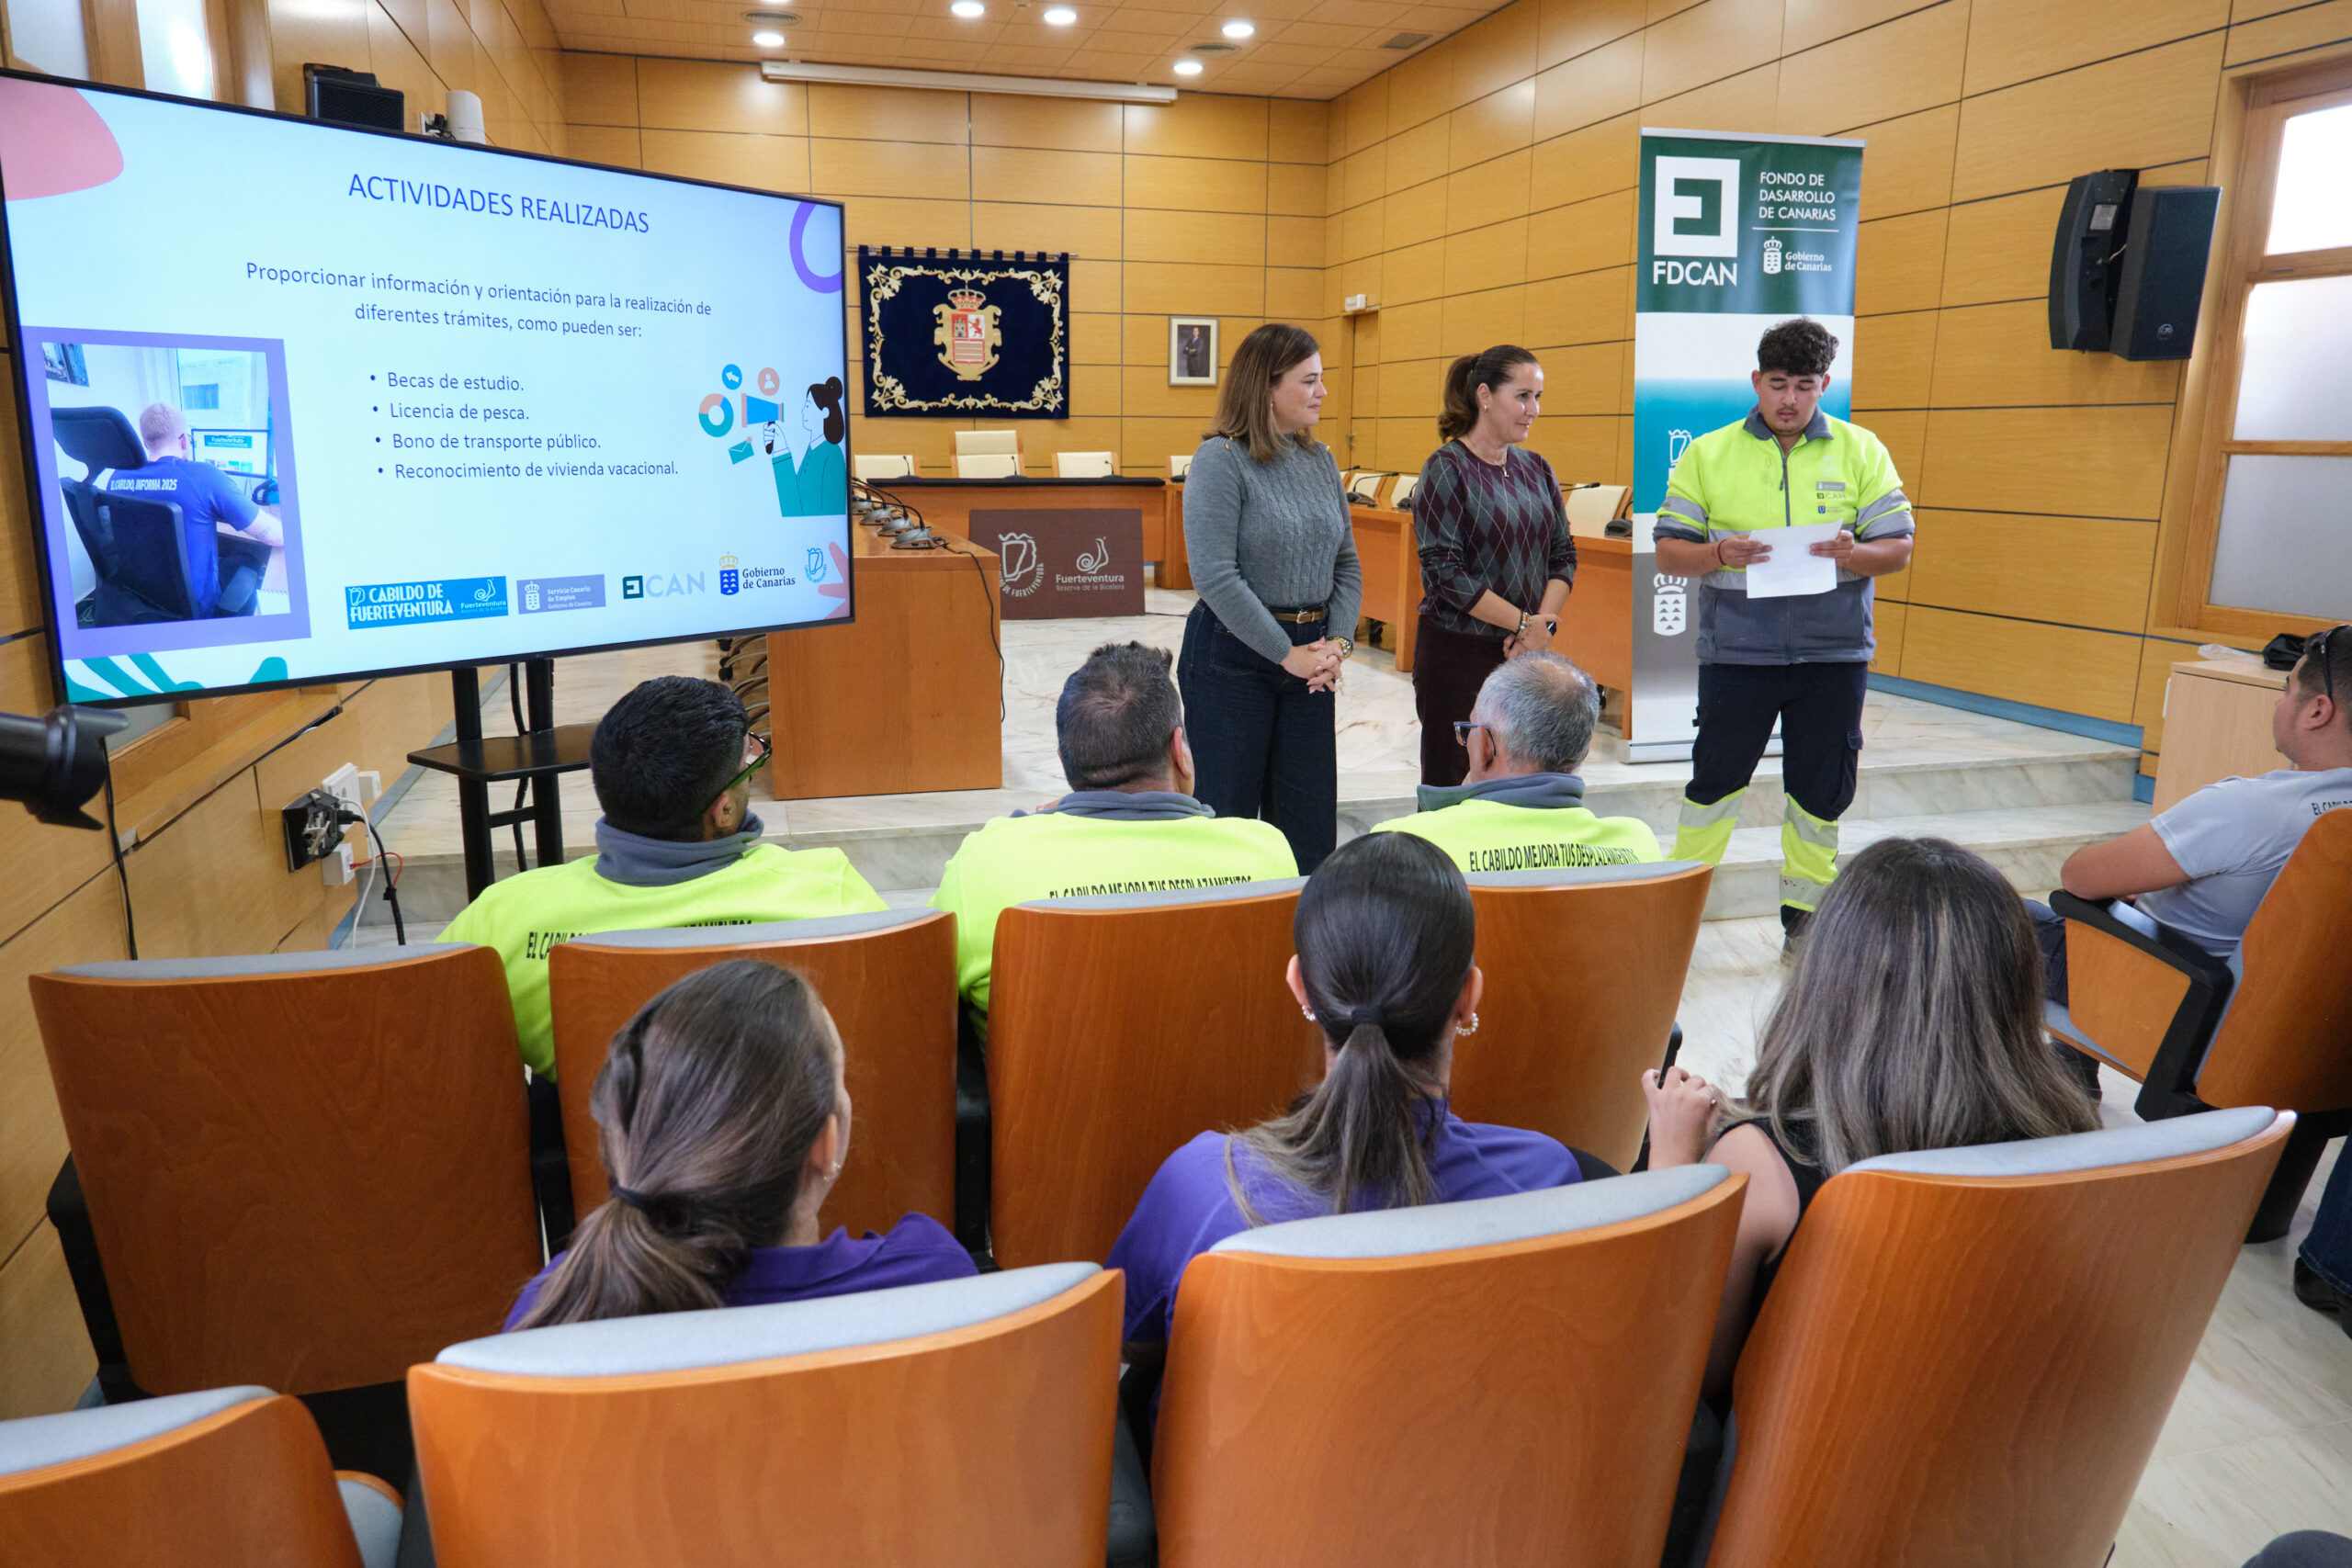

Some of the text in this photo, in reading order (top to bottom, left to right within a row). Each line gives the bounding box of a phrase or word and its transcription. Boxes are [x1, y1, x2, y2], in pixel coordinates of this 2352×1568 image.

[1760, 172, 1825, 186] FONDO DE
[348, 174, 650, 234] ACTIVIDADES REALIZADAS
[1759, 189, 1836, 204] DASARROLLO
[1758, 207, 1836, 220] DE CANARIAS
[1784, 261, 1832, 272] de Canarias
[1785, 252, 1825, 262] Gobierno
[1653, 261, 1737, 287] FDCAN
[246, 262, 712, 316] Proporcionar información y orientación para la realización de
[355, 302, 642, 340] diferentes trámites, como pueden ser:
[388, 371, 525, 391] Becas de estudio.
[390, 402, 529, 424] Licencia de pesca.
[392, 433, 601, 453] Bono de transporte público.
[395, 460, 679, 479] Reconocimiento de vivienda vacacional.
[161, 479, 177, 491] 2025
[742, 567, 785, 579] Gobierno
[742, 576, 796, 589] de Canarias
[1056, 573, 1125, 583] Fuerteventura
[368, 583, 444, 604] CABILDO DE
[645, 571, 706, 598] CAN
[350, 599, 454, 623] FUERTEVENTURA
[460, 600, 507, 610] Fuerteventura
[1470, 852, 1480, 872] EL
[1482, 846, 1522, 872] CABILDO
[1523, 843, 1560, 869] MEJORA
[1559, 843, 1576, 867] TUS
[526, 931, 537, 959] EL
